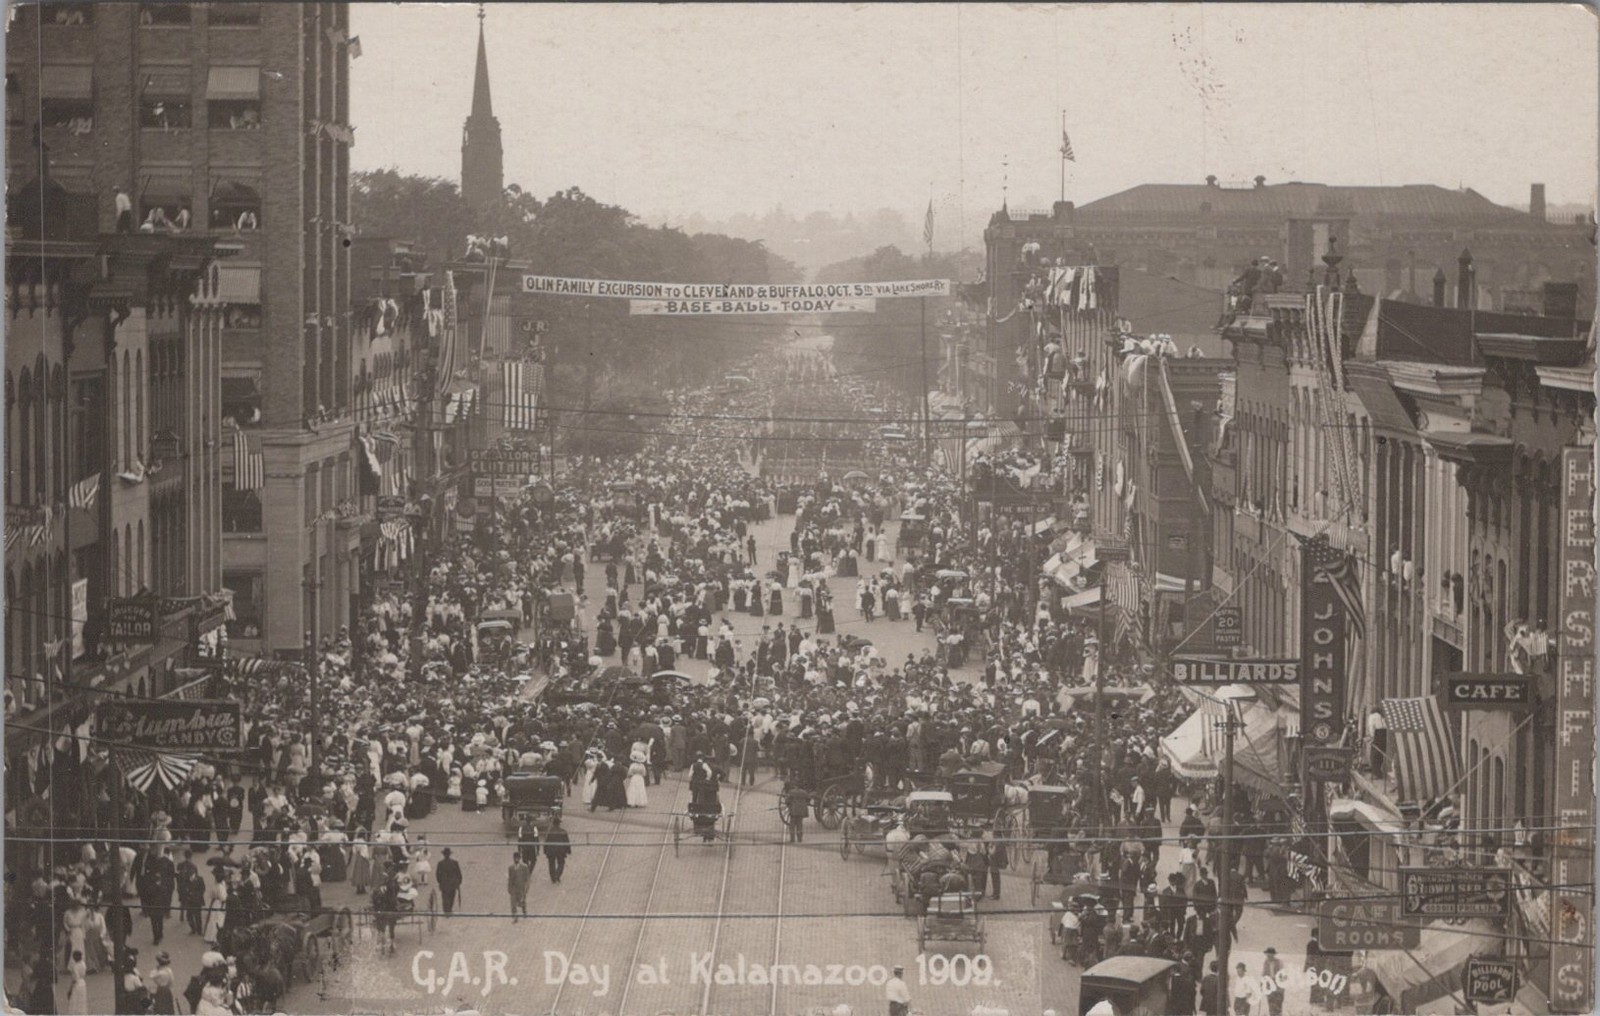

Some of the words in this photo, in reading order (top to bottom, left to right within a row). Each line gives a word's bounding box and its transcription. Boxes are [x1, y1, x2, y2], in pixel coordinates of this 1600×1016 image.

[526, 276, 553, 291] OLIN
[555, 278, 595, 295] FAMILY
[598, 281, 662, 297] EXCURSION
[667, 287, 681, 297] TO
[876, 285, 890, 295] VIA
[110, 621, 152, 637] TAILOR
[1313, 602, 1334, 719] JOHNS
[1174, 663, 1297, 681] BILLIARDS
[155, 728, 217, 745] CANDY
[1335, 930, 1405, 946] ROOMS
[1473, 979, 1503, 995] POOL
